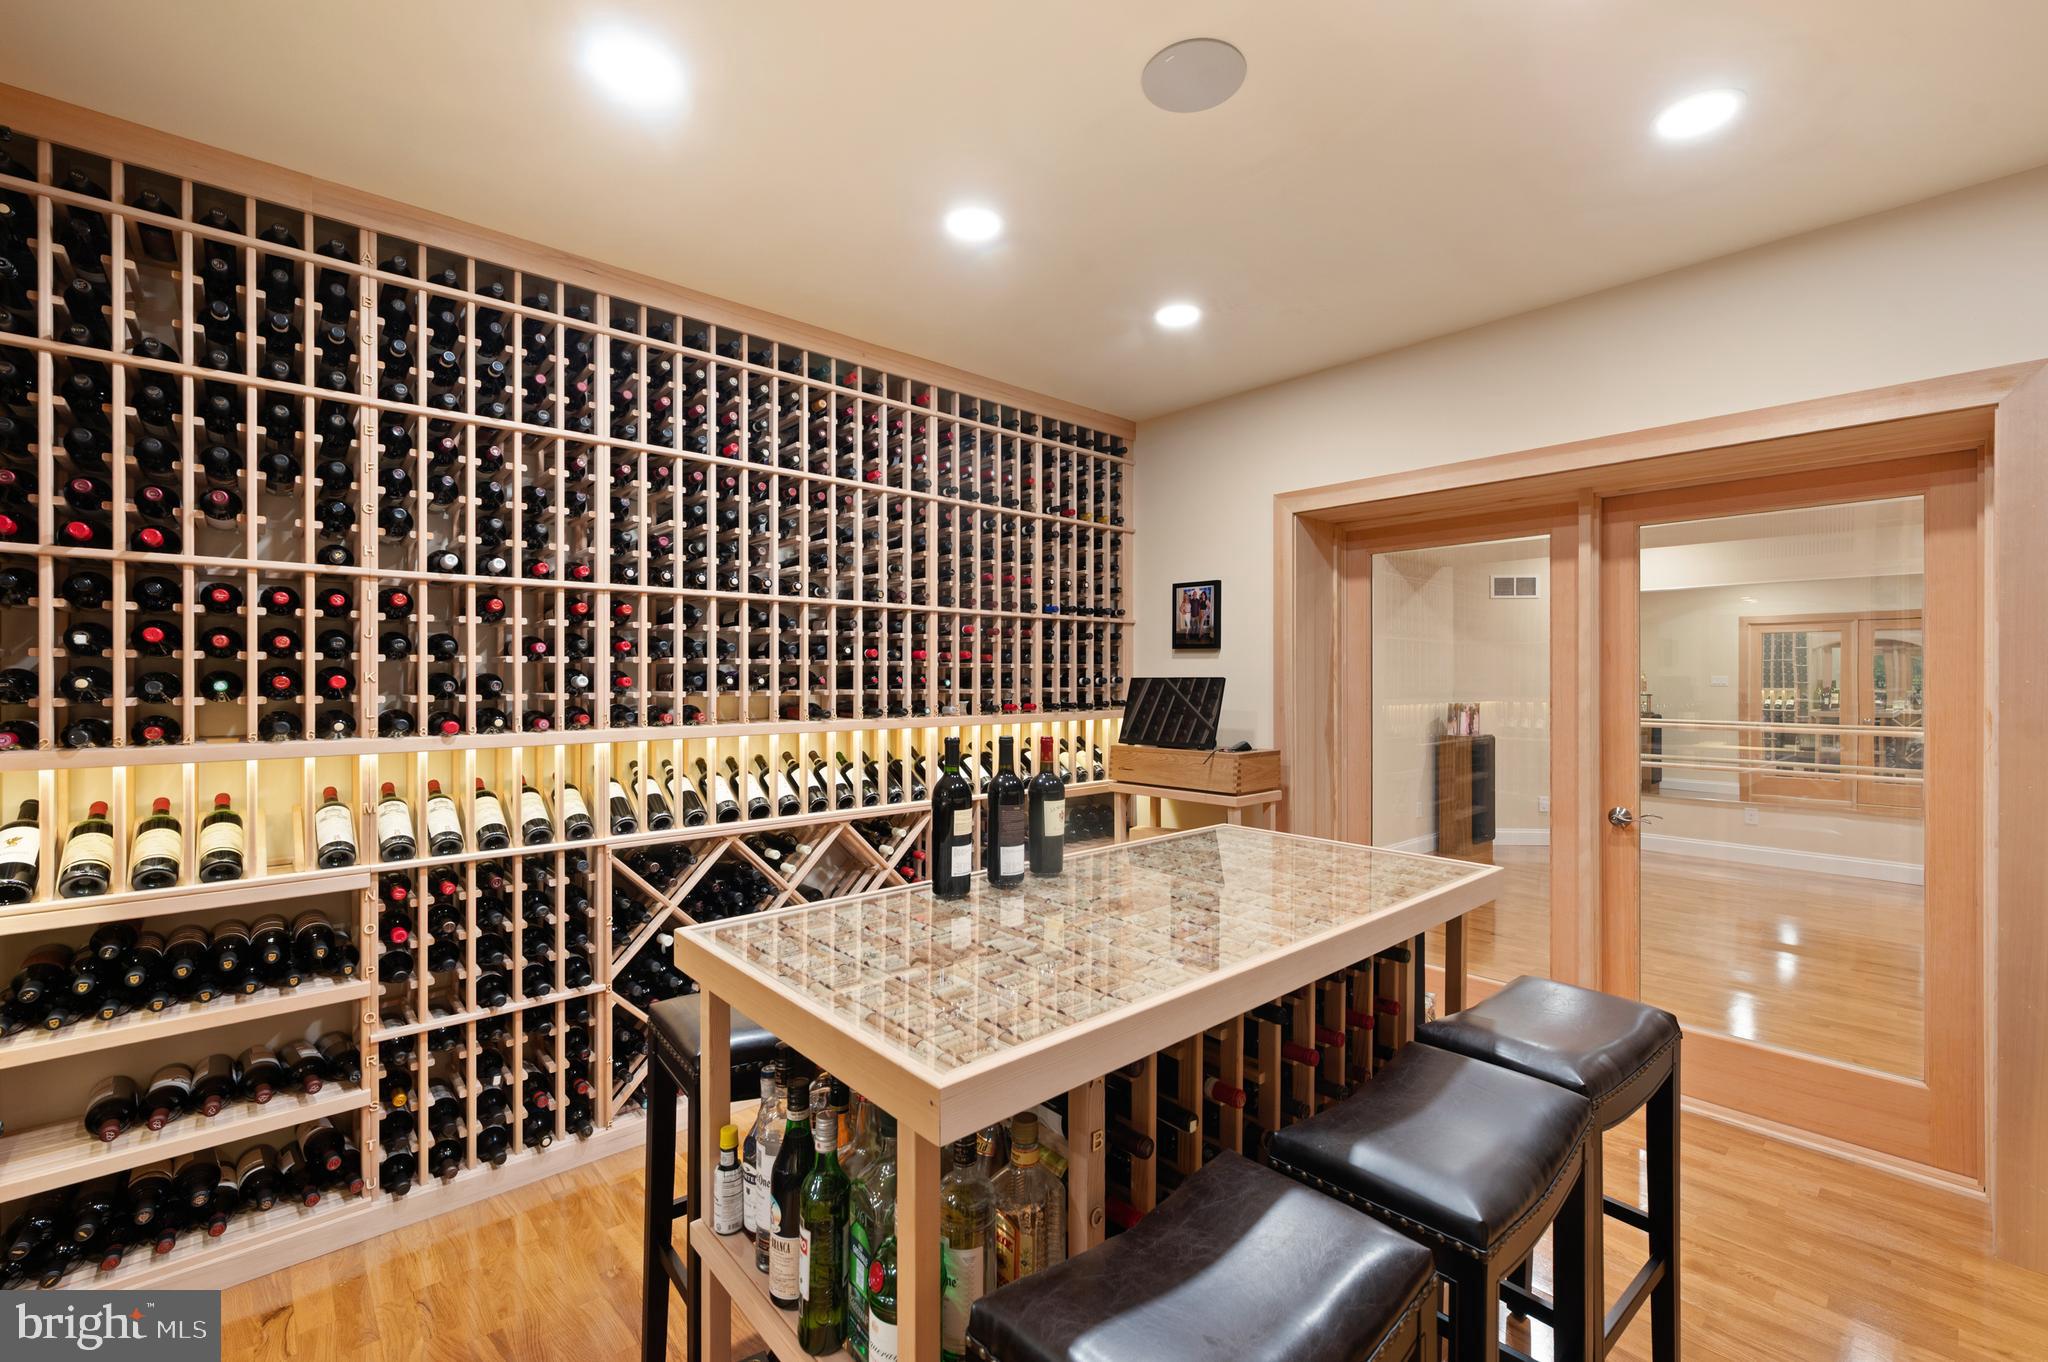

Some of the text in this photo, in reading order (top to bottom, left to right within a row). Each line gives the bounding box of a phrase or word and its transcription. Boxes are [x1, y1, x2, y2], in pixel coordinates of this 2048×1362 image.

[361, 251, 374, 264] A
[362, 295, 373, 308] B
[362, 333, 374, 346] C
[362, 372, 374, 386] D
[363, 424, 374, 437] E
[364, 461, 374, 474] F
[362, 502, 374, 515] G
[363, 545, 375, 557] H
[364, 627, 374, 639] J
[364, 671, 376, 683] K
[366, 707, 374, 719] L
[306, 731, 315, 741] 6
[369, 728, 377, 738] 7
[420, 728, 427, 737] 8
[469, 726, 477, 735] 9
[39, 738, 50, 750] 2
[113, 737, 124, 748] 3
[183, 735, 193, 745] 4
[248, 733, 257, 743] 5
[363, 803, 377, 815] M
[365, 889, 377, 902] N
[606, 916, 613, 926] 2
[364, 923, 376, 935] O
[365, 966, 376, 979] P
[364, 1012, 376, 1025] Q
[366, 1055, 377, 1067] R
[369, 1101, 380, 1112] S
[366, 1139, 377, 1151] T
[1091, 1129, 1104, 1152] B
[366, 1177, 377, 1190] U
